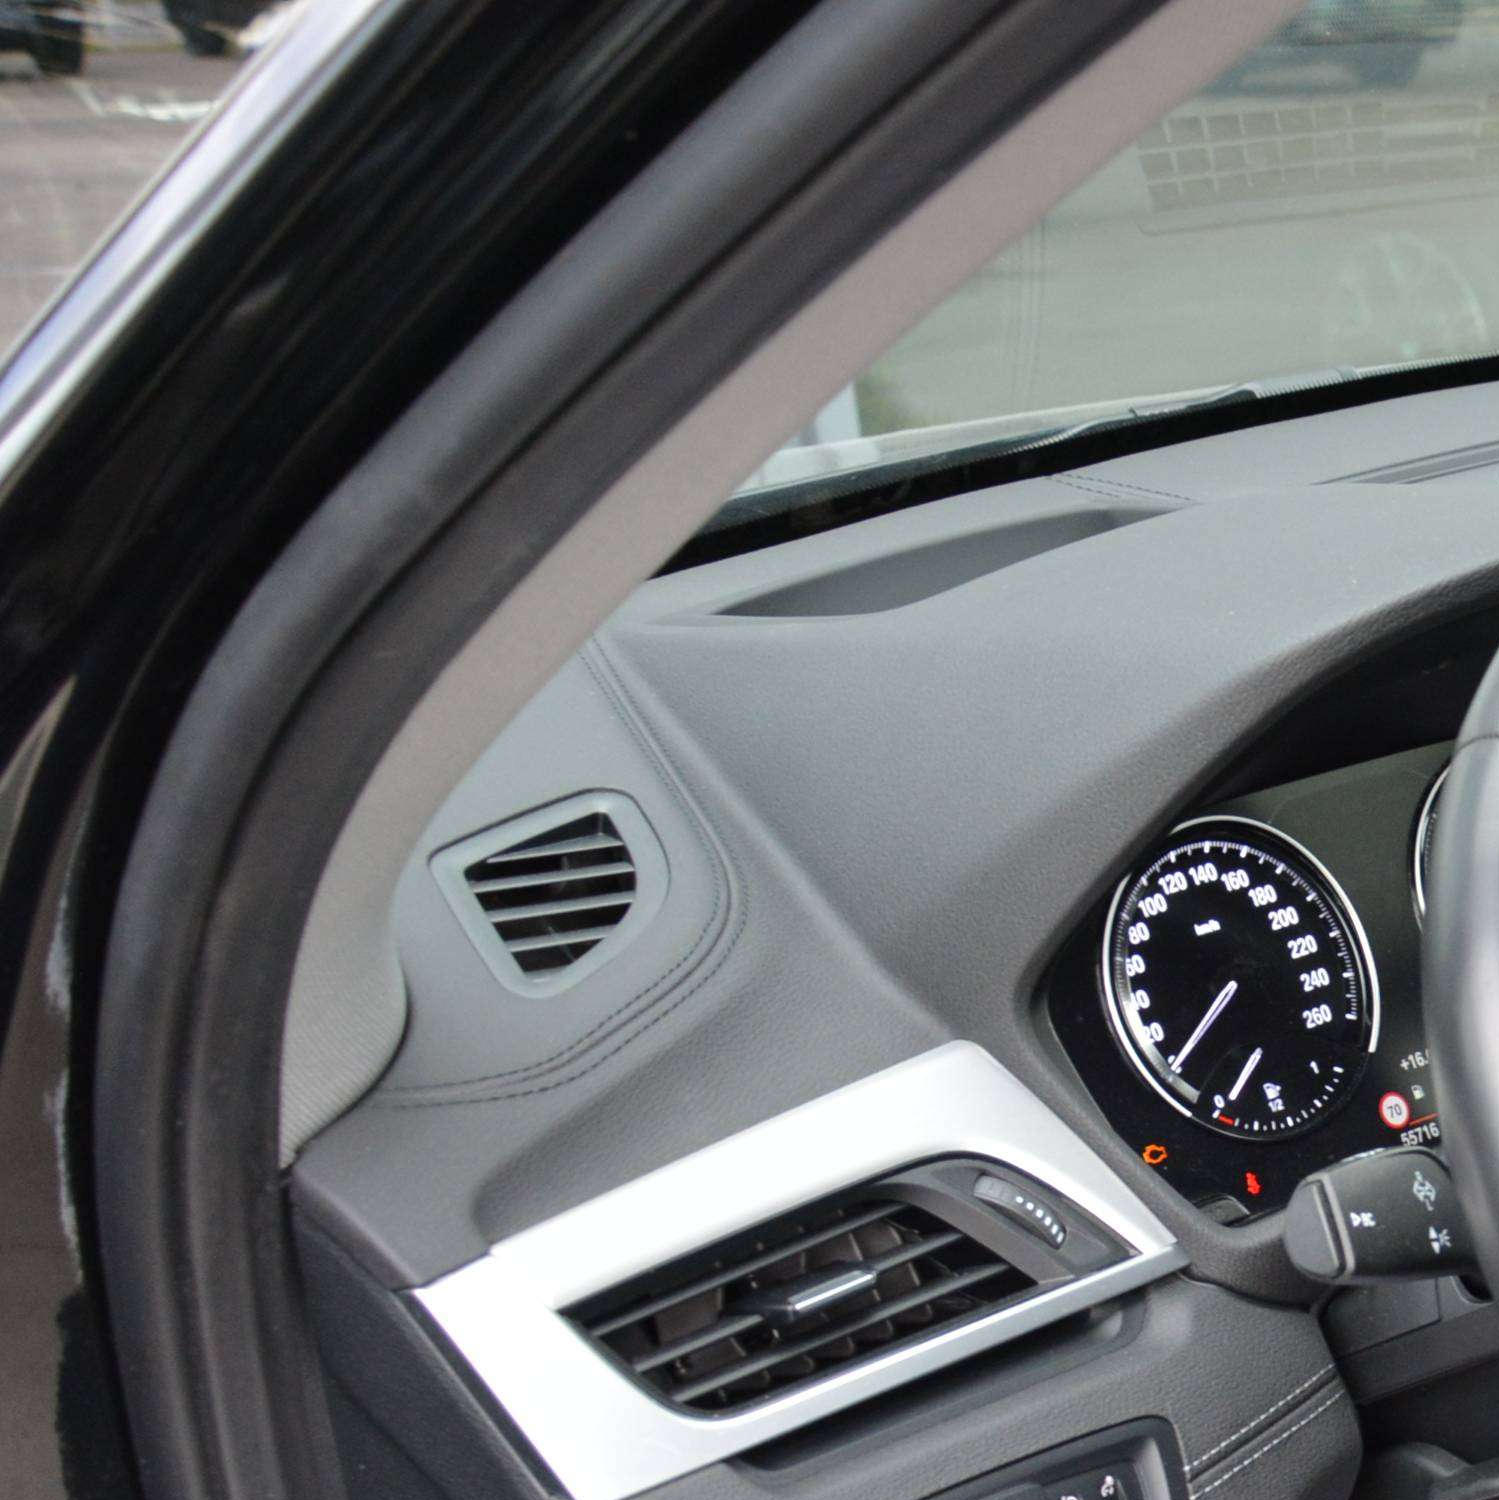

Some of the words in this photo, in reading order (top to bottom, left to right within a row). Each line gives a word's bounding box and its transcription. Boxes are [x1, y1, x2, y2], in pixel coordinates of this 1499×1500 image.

[1158, 871, 1188, 895] 120
[1188, 862, 1218, 886] 140
[1221, 868, 1250, 892] 160
[1138, 893, 1168, 919] 100
[1248, 883, 1278, 907] 180
[1268, 905, 1299, 931] 200
[1128, 921, 1150, 945] 80
[1287, 934, 1318, 960] 220
[1125, 954, 1146, 977] 60
[1300, 967, 1330, 992] 240
[1302, 1004, 1333, 1029] 260
[1310, 1061, 1320, 1075] 1
[1400, 1048, 1429, 1071] +16.
[1267, 1098, 1285, 1113] 1/2
[1386, 1103, 1403, 1119] 70
[1400, 1122, 1440, 1147] 55716
